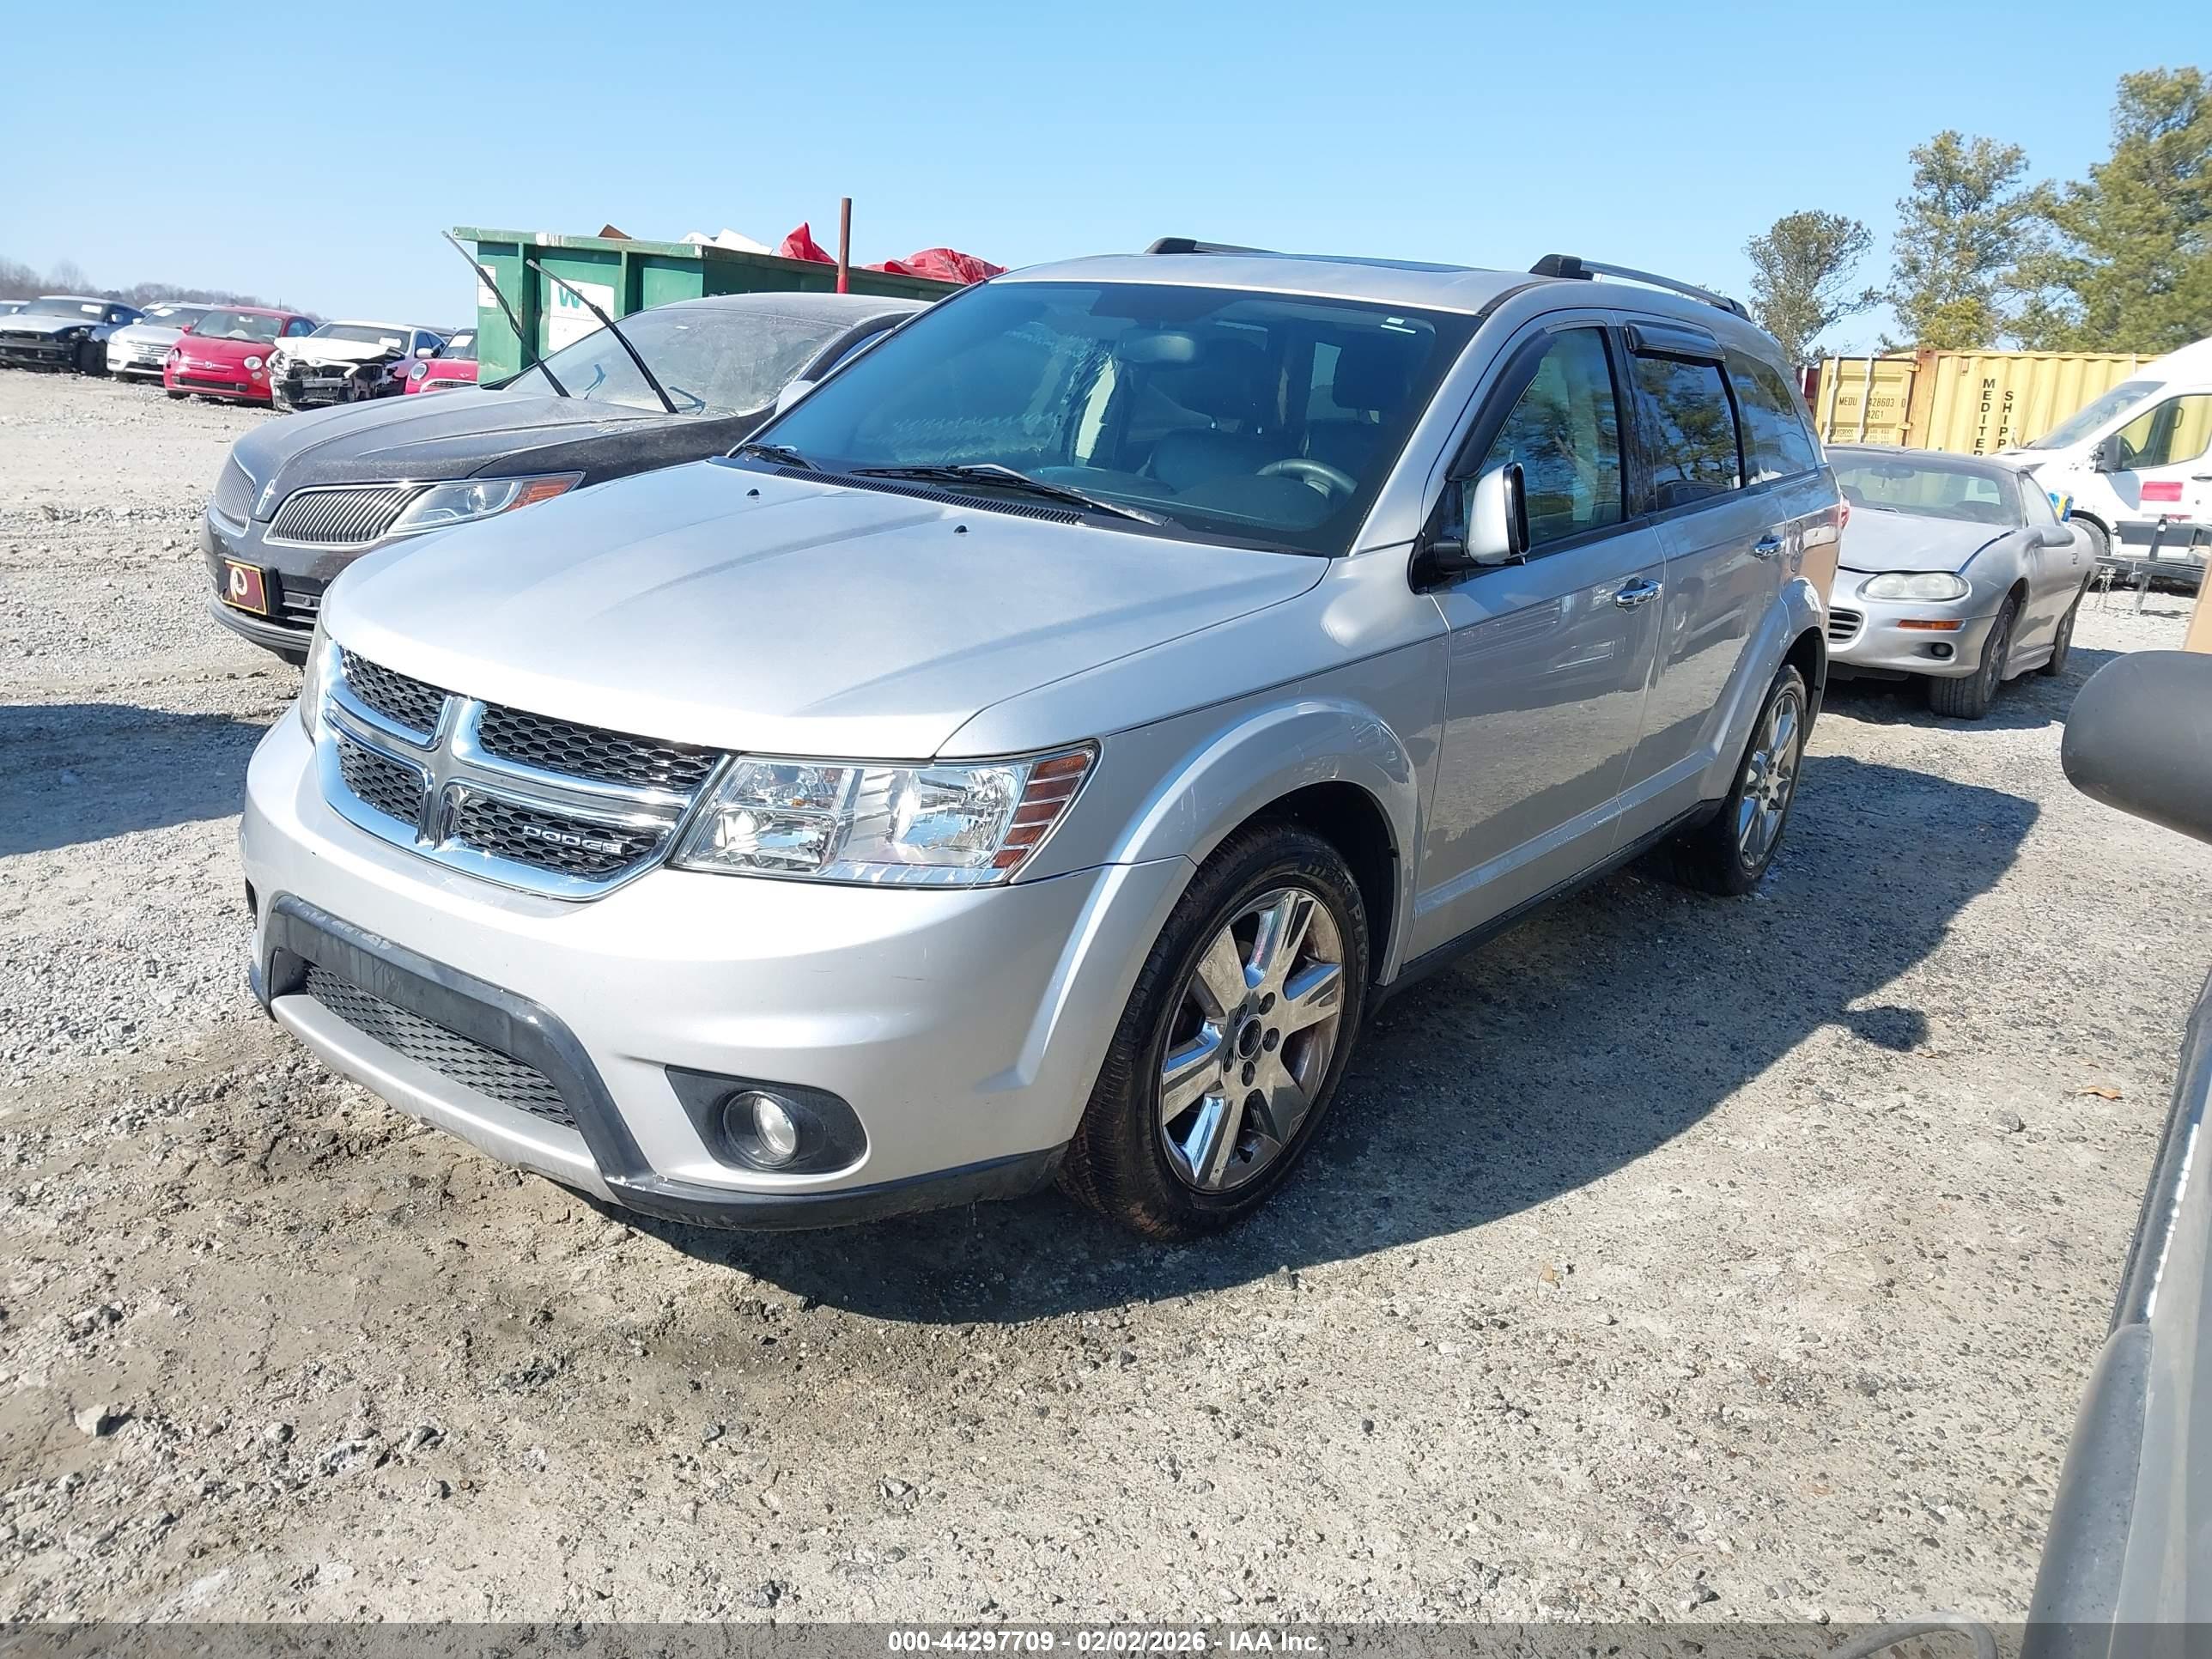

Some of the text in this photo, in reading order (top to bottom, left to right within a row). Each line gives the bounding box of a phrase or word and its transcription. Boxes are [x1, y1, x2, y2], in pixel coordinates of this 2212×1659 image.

[1838, 397, 1858, 406] MEDU
[1997, 391, 2014, 448] SHIPP
[523, 824, 623, 854] DODGE
